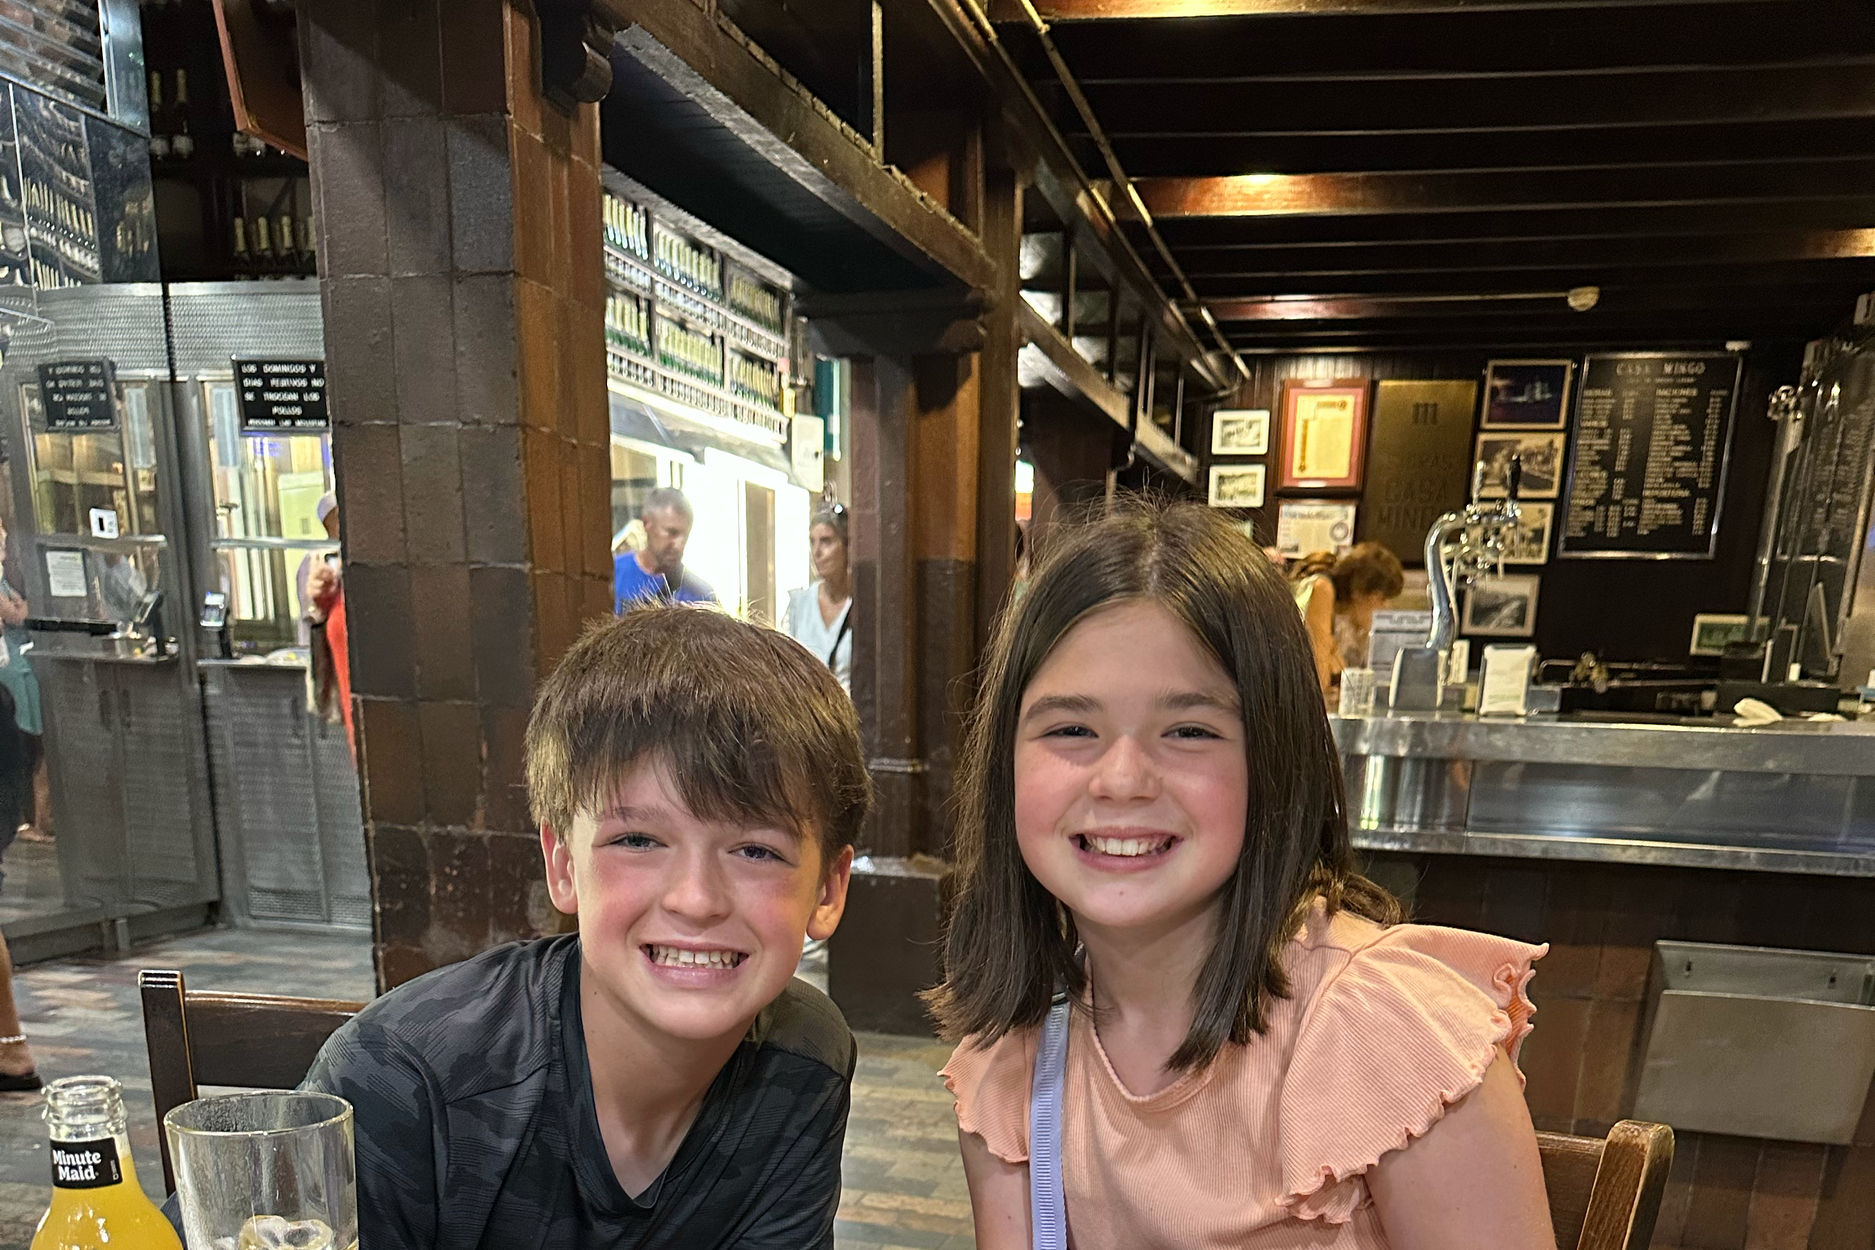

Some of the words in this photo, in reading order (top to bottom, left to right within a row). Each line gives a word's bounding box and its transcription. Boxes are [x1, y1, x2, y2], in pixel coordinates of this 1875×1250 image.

[241, 363, 257, 374] LOS
[262, 363, 307, 374] DOMINGOS
[303, 391, 320, 402] LOS
[271, 405, 303, 416] POLLOS
[52, 1149, 102, 1166] Minute
[57, 1165, 96, 1181] Maid
